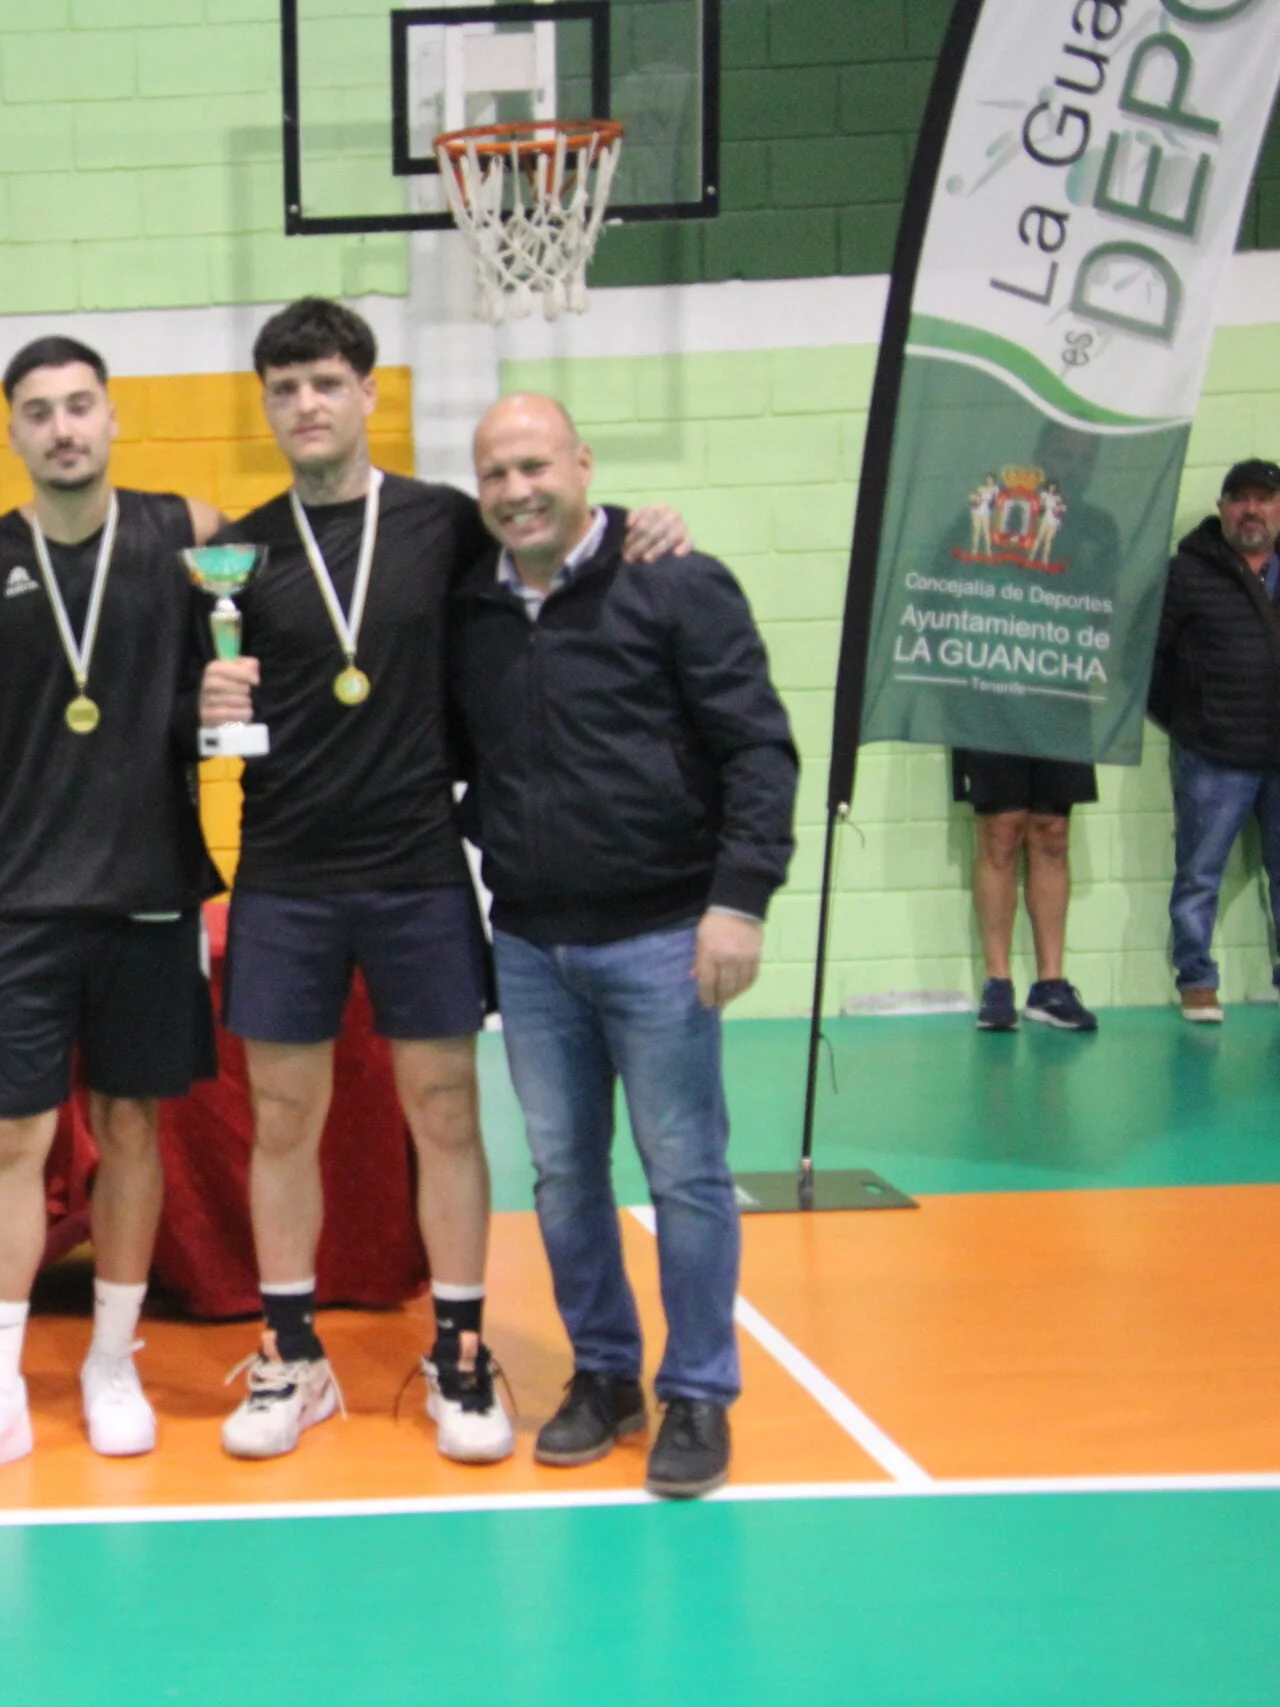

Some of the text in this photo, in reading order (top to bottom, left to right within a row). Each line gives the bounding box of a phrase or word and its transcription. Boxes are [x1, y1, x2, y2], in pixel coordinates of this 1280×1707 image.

[1069, 0, 1256, 341] DEP
[989, 205, 1070, 306] La
[1061, 330, 1094, 367] es
[1001, 583, 1024, 601] de
[1030, 586, 1113, 613] Deportes
[900, 603, 1111, 650] Ayuntamiento de
[893, 635, 1108, 684] LA GUANCHA
